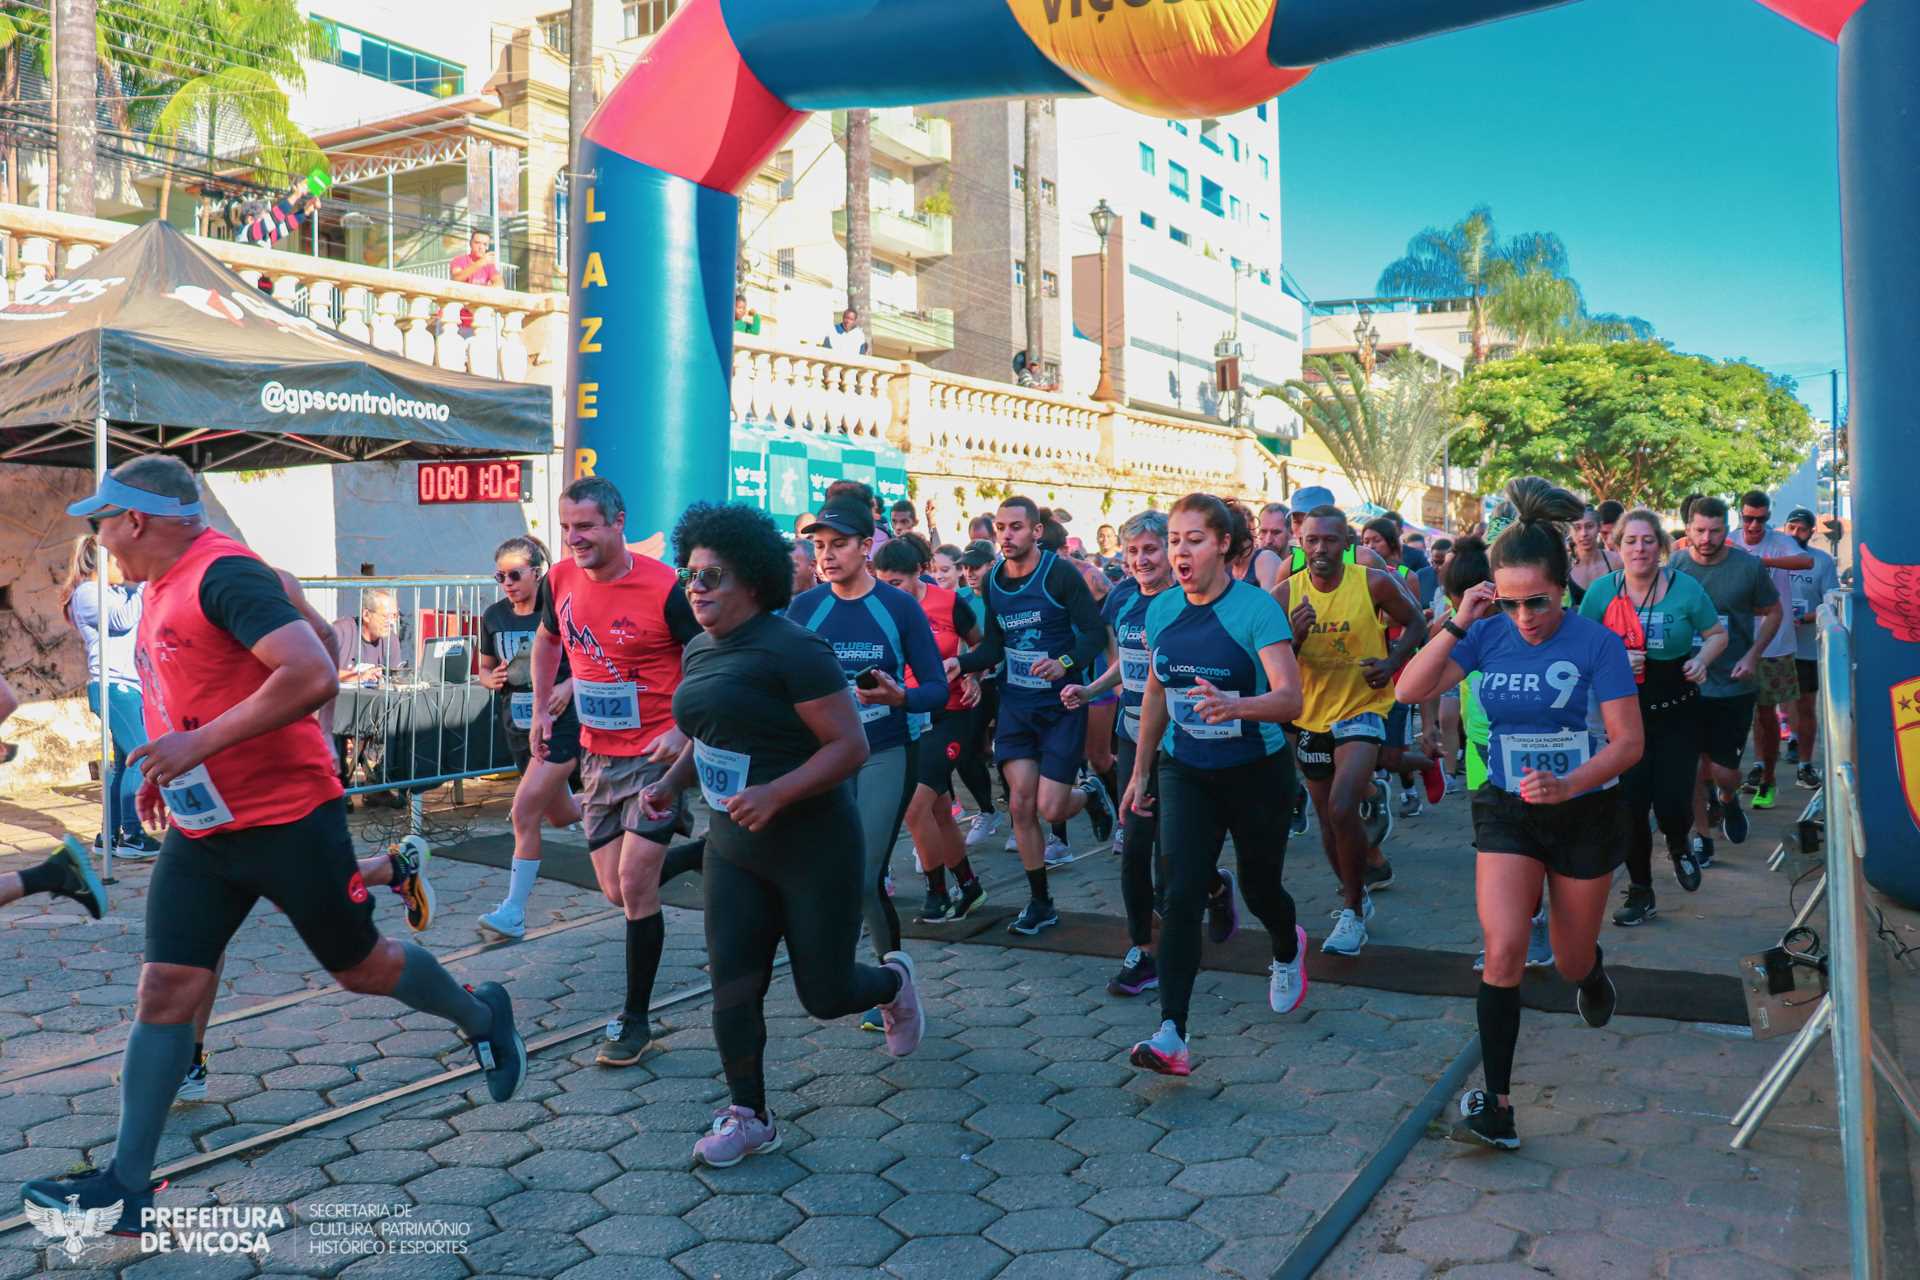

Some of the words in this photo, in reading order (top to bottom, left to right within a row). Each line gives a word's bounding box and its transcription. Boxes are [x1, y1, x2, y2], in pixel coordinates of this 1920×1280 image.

[574, 187, 608, 480] LAZER
[261, 381, 449, 422] @gpscontrolcrono
[1311, 621, 1350, 634] AIXA
[833, 642, 872, 651] CLUBE
[1127, 662, 1150, 679] 22
[1481, 671, 1541, 691] YPER
[585, 696, 623, 716] 312
[1520, 752, 1569, 775] 189
[702, 764, 728, 793] 99
